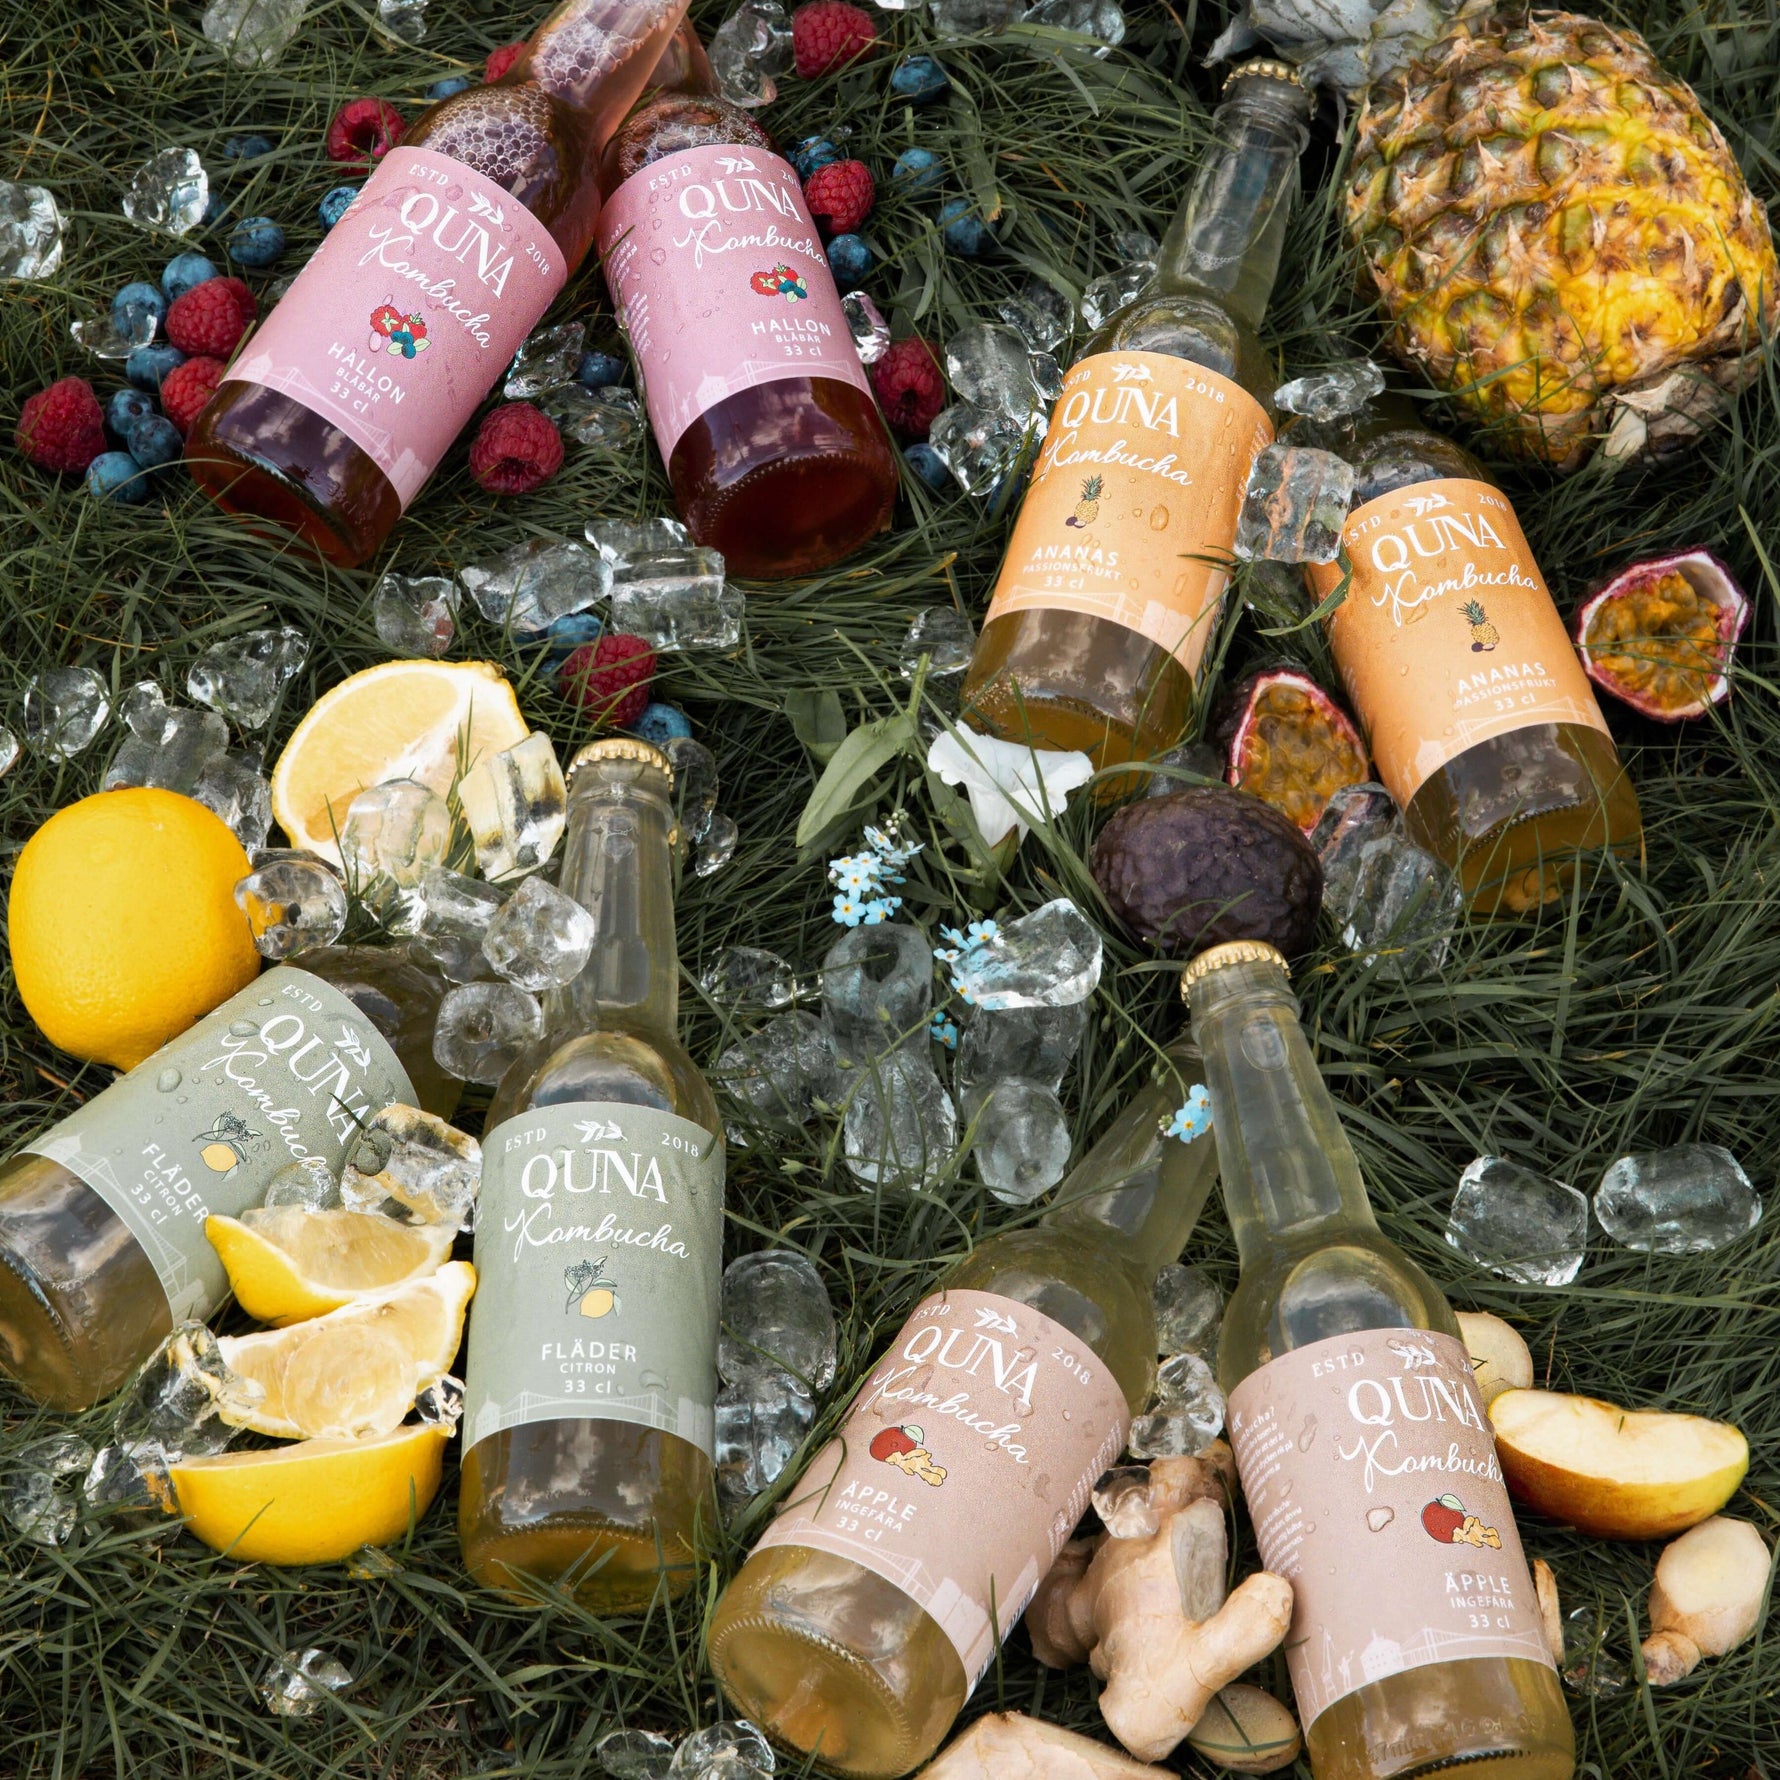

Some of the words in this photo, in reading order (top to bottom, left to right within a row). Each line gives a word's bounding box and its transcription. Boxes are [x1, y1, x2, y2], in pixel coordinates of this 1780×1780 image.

[649, 165, 692, 191] ESTD
[679, 178, 804, 224] QUNA
[409, 162, 450, 188] ESTD
[525, 241, 551, 276] 2018
[400, 192, 516, 299] QUNA
[673, 219, 827, 269] Kombucha
[358, 223, 491, 349] Kombucha
[751, 318, 832, 337] HALLON
[775, 331, 822, 344] BLÅBÄR
[784, 345, 803, 357] 33
[809, 345, 823, 357] cl
[327, 341, 406, 406] HALLON
[335, 365, 381, 404] BLÅBÄR
[1184, 377, 1226, 404] 2018
[328, 382, 349, 400] 33
[353, 398, 369, 415] cl
[1061, 386, 1181, 438] QUNA
[1040, 429, 1193, 487] Kombucha
[1477, 493, 1507, 512] 2018
[1031, 543, 1120, 567] ANANAS
[1370, 512, 1506, 573] QUNA
[1022, 561, 1122, 582] PASSIONSFRUKT
[1044, 574, 1063, 588] 33
[1069, 577, 1085, 590] cl
[1371, 562, 1539, 628] Kombucha
[1455, 678, 1557, 707] PASSIONSFRUKT
[1458, 661, 1547, 694] ANANAS
[1494, 696, 1515, 712] 33
[1521, 691, 1536, 705] cl
[281, 983, 324, 1012] ESTD
[259, 1013, 368, 1146] QUNA
[200, 1032, 328, 1170] Kombuch
[504, 1127, 547, 1153] ESTD
[661, 1132, 700, 1157] 2018
[142, 1142, 209, 1225] FLÄDER
[143, 1168, 183, 1217] CITRON
[520, 1148, 669, 1204] QUNA
[130, 1183, 151, 1205] 33
[150, 1206, 169, 1226] cl
[504, 1202, 690, 1263] Kombucha
[541, 1338, 637, 1362] FLÄDER
[902, 1325, 1039, 1406] QUNA
[1050, 1346, 1091, 1386] 2018
[1312, 1351, 1366, 1379] ESTD
[559, 1362, 616, 1374] CITRON
[563, 1379, 586, 1393] 33
[595, 1379, 612, 1394] cl
[1348, 1375, 1485, 1432] QUNA
[861, 1365, 1030, 1465] Kombucha
[834, 1499, 904, 1534] INGEFÄRA
[841, 1480, 918, 1522] ÄPPLE
[835, 1515, 858, 1532] 33
[864, 1527, 883, 1543] cl
[1445, 1571, 1511, 1595] ÄPPLE
[1450, 1596, 1515, 1610] INGEFÄRA
[1468, 1614, 1491, 1629] 33
[1497, 1614, 1511, 1629] cl
